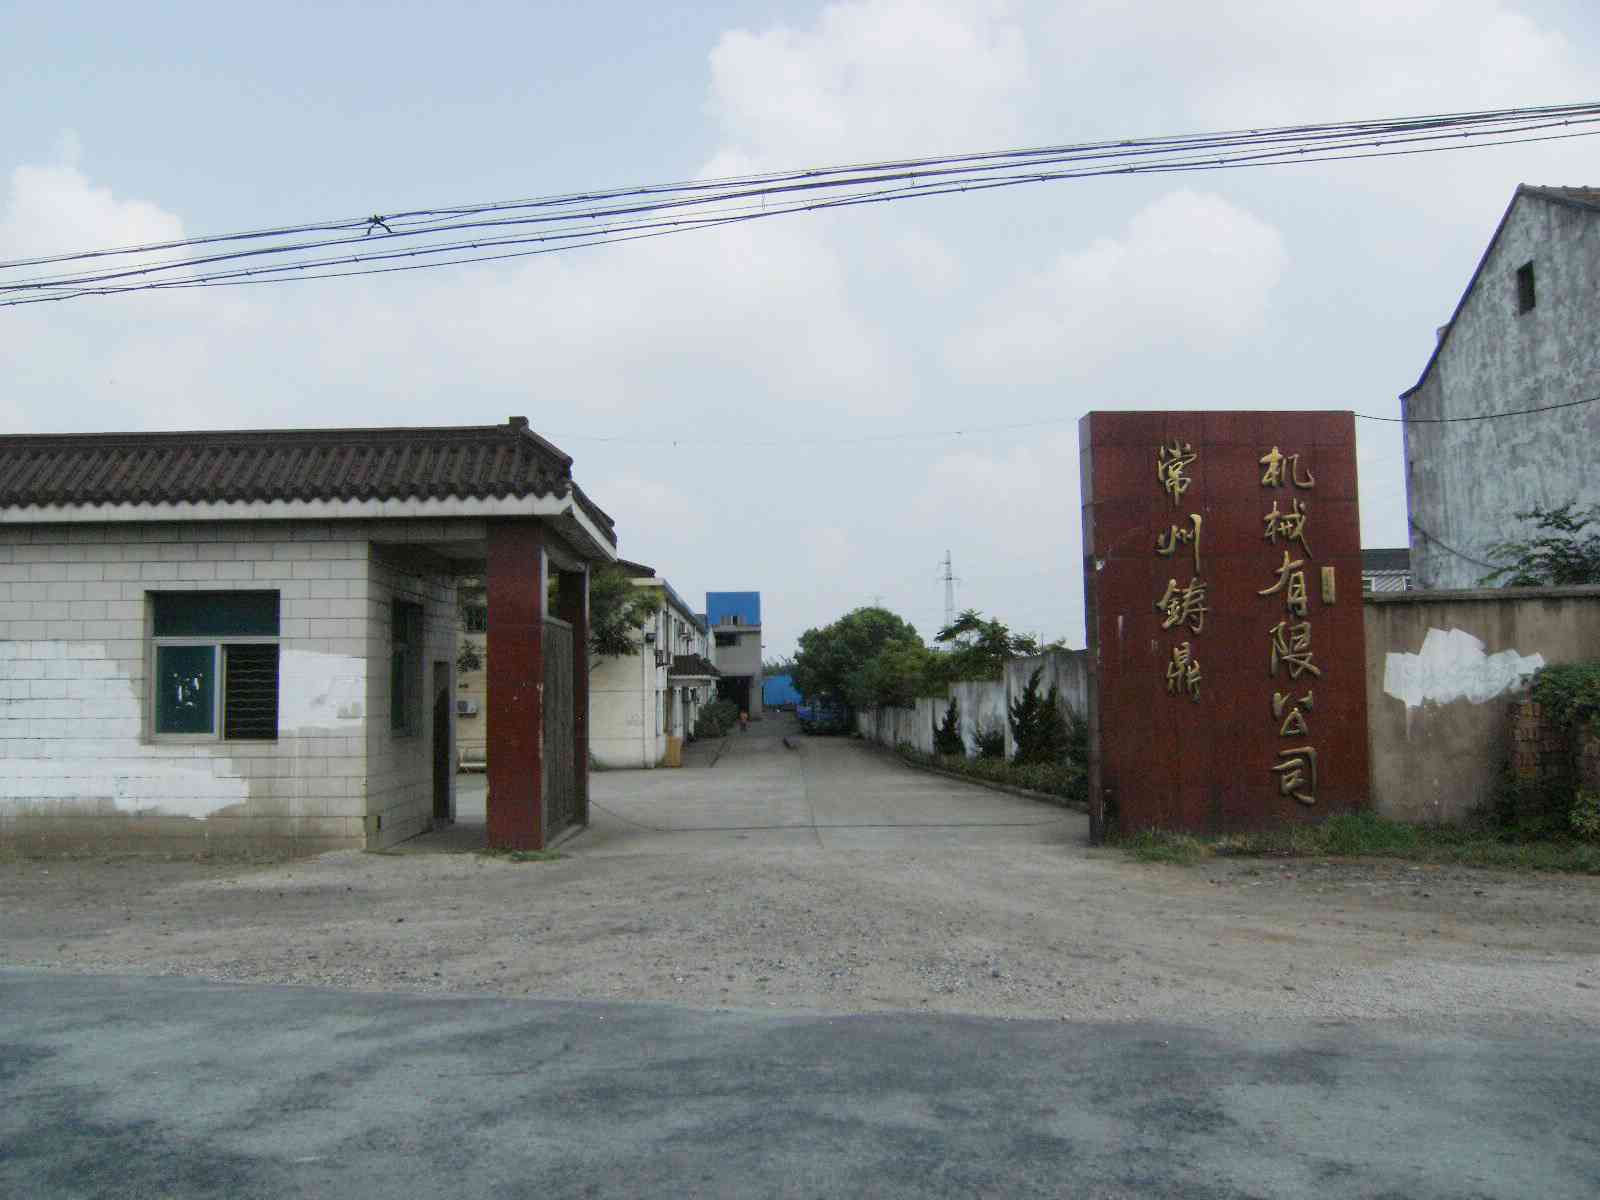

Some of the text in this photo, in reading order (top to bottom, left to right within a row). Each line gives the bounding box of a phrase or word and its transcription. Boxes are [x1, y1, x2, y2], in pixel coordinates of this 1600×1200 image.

[1258, 446, 1320, 804] 机械有限公司
